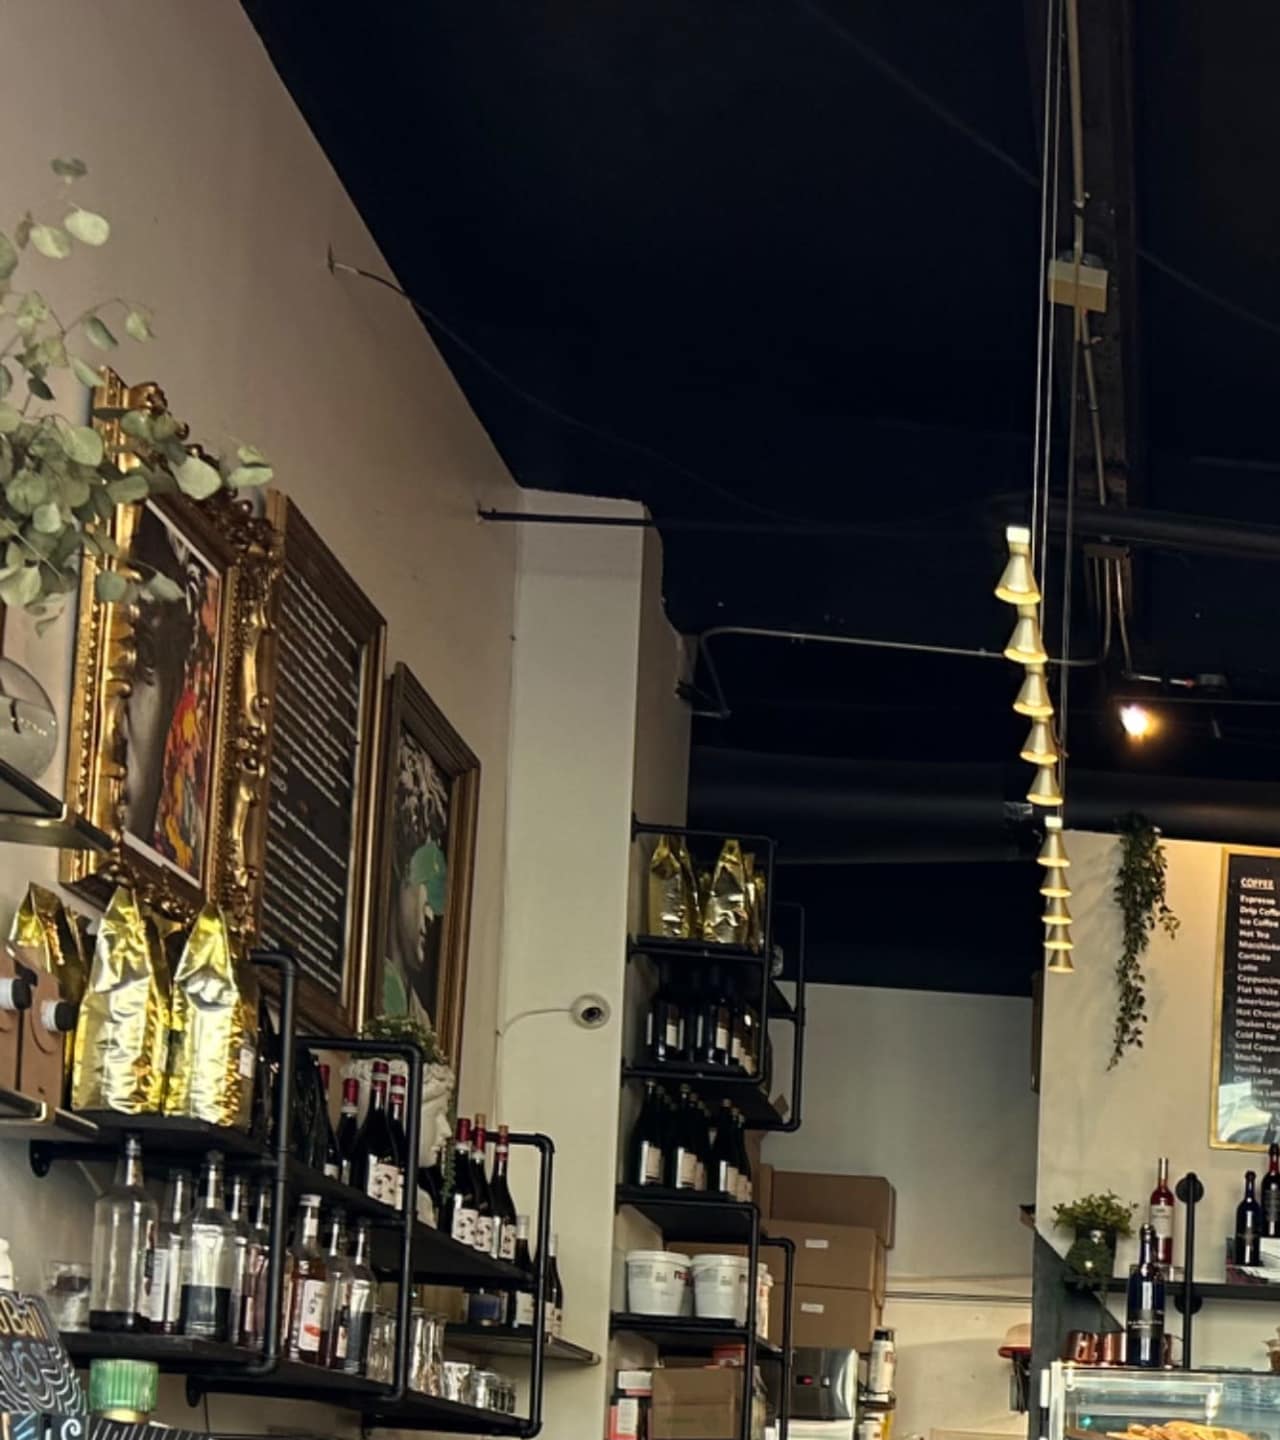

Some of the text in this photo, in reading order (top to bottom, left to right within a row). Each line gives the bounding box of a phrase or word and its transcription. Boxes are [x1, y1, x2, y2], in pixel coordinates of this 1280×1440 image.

[1240, 877, 1275, 890] COFFEE
[1239, 894, 1276, 906] Espresso
[1239, 907, 1257, 918] Drip
[1253, 919, 1280, 929] Coffee
[1238, 930, 1255, 939] Hot
[1256, 930, 1271, 940] Tea
[1237, 952, 1272, 963] Cortado
[1237, 963, 1259, 973] Latte
[1236, 985, 1253, 995] Flat
[1253, 987, 1280, 997] White
[1236, 997, 1280, 1008] Americano
[1235, 1008, 1252, 1017] Hot
[1234, 1030, 1254, 1041] Cold
[1254, 1032, 1278, 1042] Brew
[1233, 1053, 1263, 1064] Mocha
[1233, 1064, 1262, 1075] Vanilla
